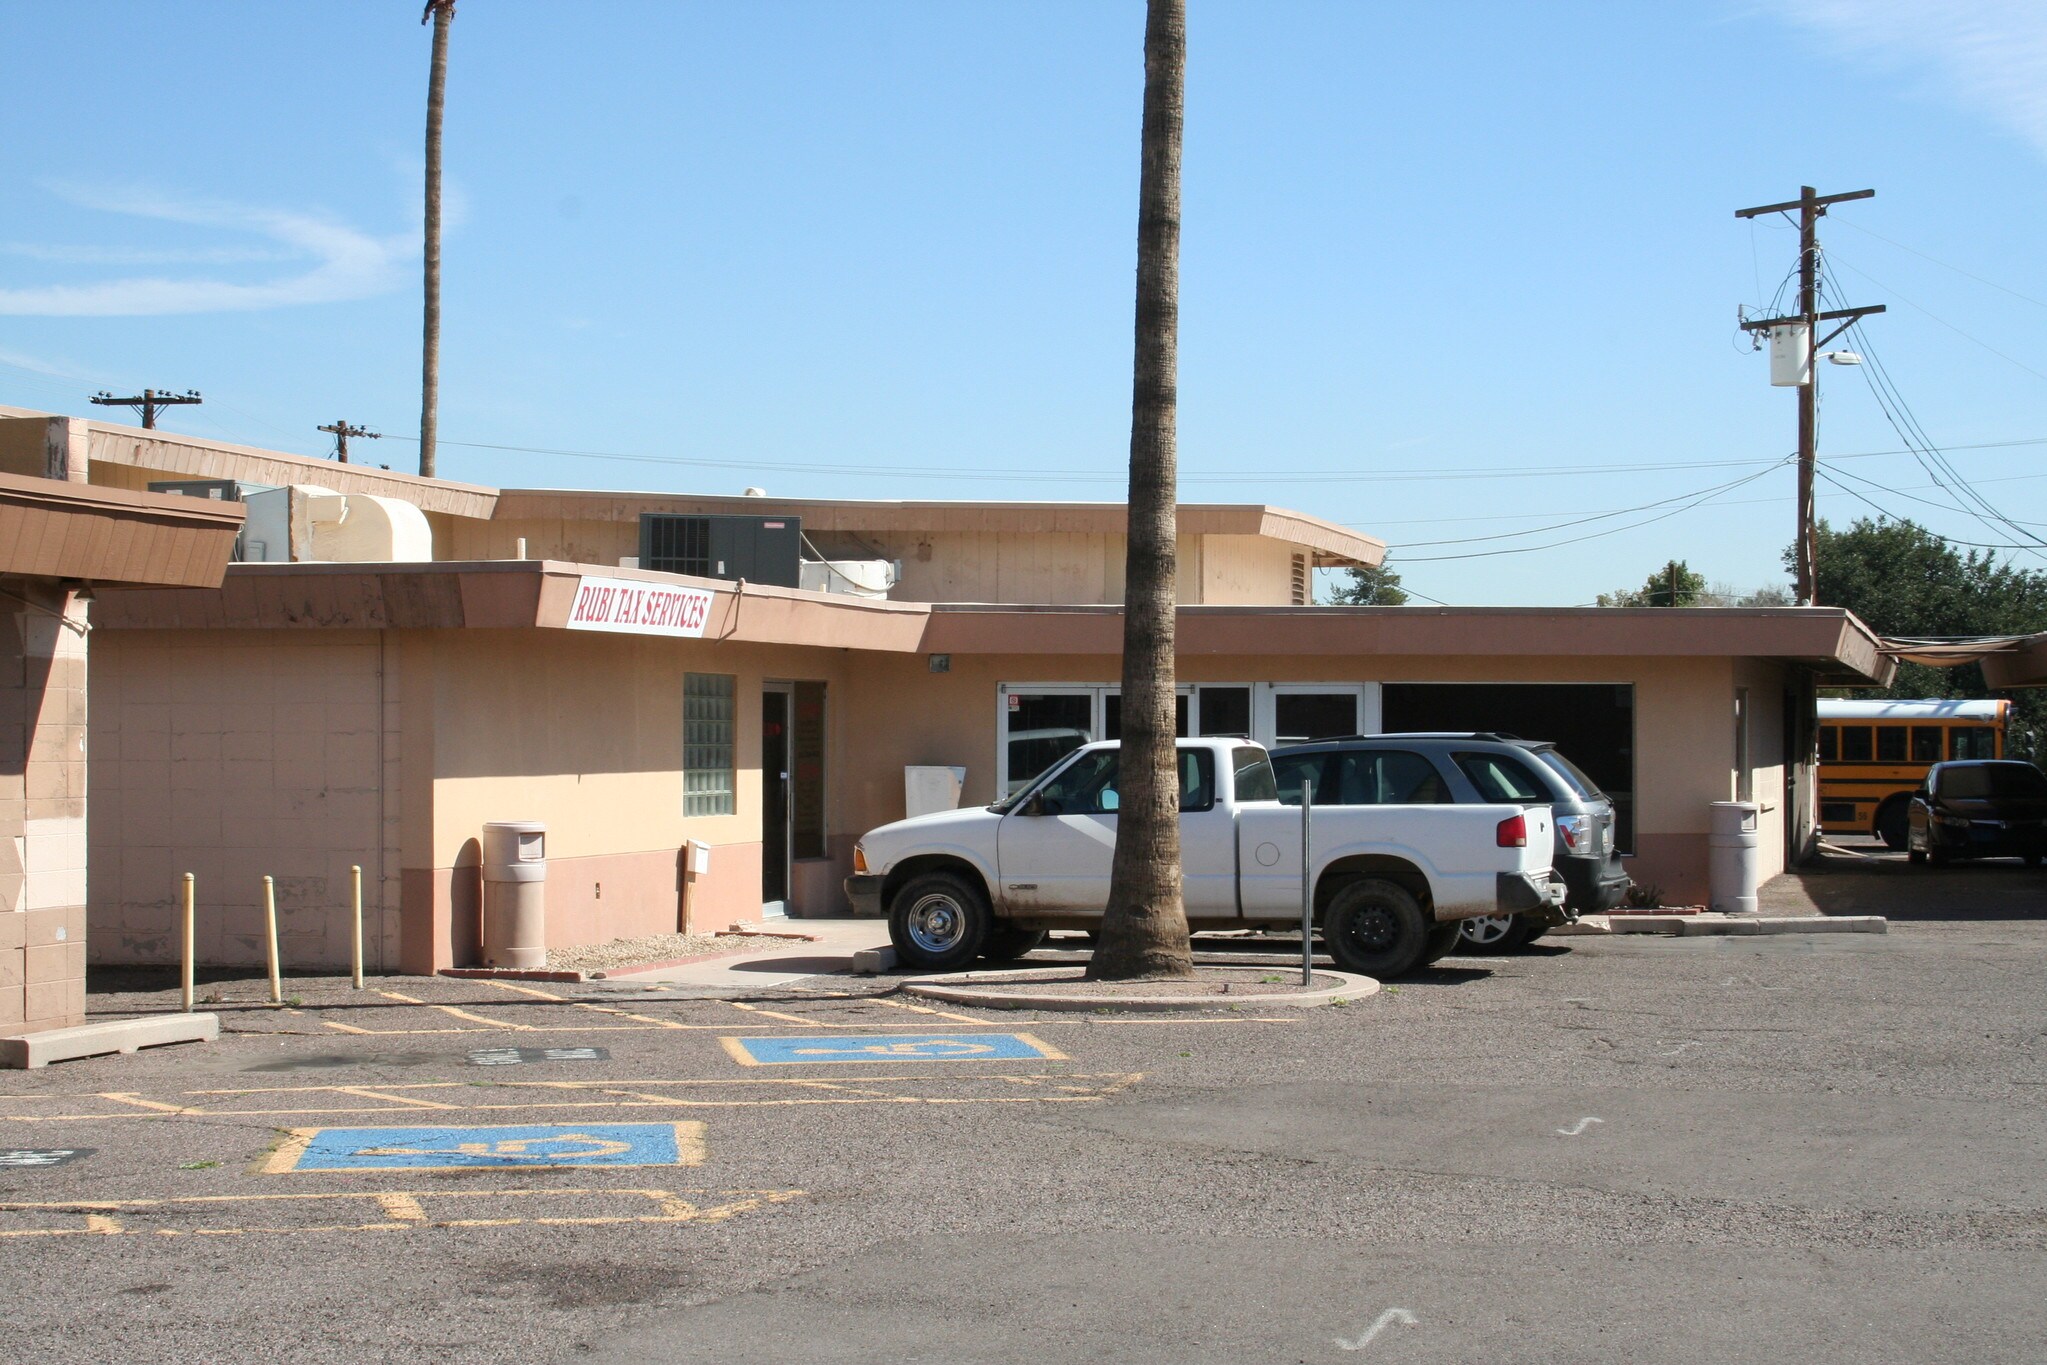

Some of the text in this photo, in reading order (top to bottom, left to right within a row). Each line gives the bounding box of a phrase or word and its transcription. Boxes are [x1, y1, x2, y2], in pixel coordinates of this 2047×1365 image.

[574, 586, 707, 629] RUBI TAX SERVICES
